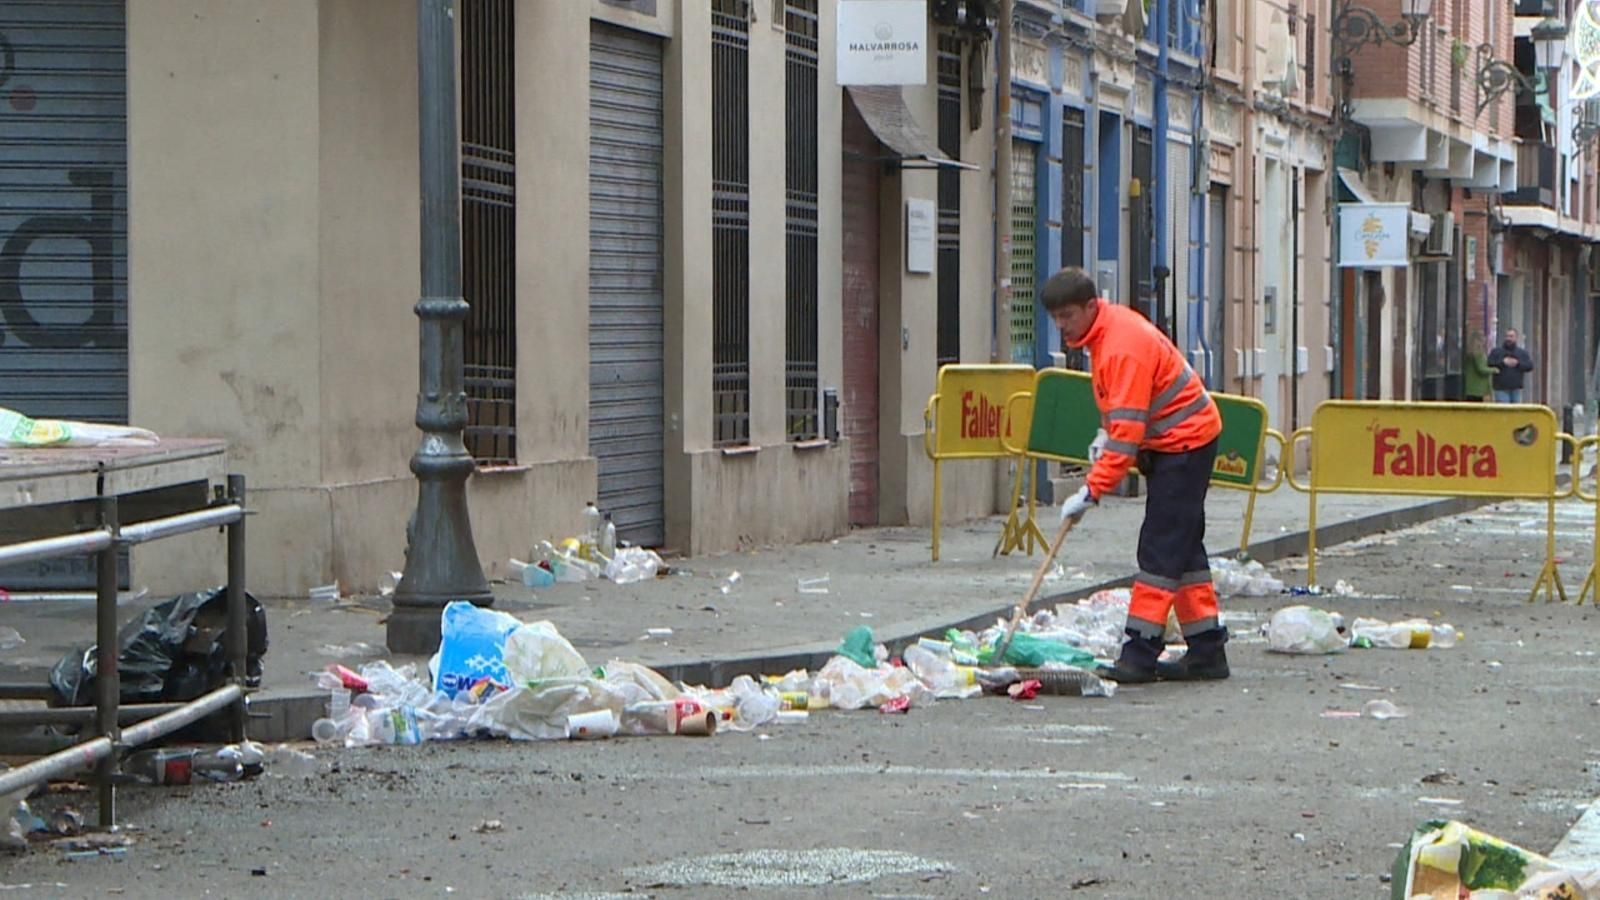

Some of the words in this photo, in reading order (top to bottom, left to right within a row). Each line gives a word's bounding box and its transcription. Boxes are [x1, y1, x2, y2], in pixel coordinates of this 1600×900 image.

[849, 41, 919, 51] MALVARROSA
[961, 390, 1012, 439] Faller
[1373, 427, 1498, 478] Fallera
